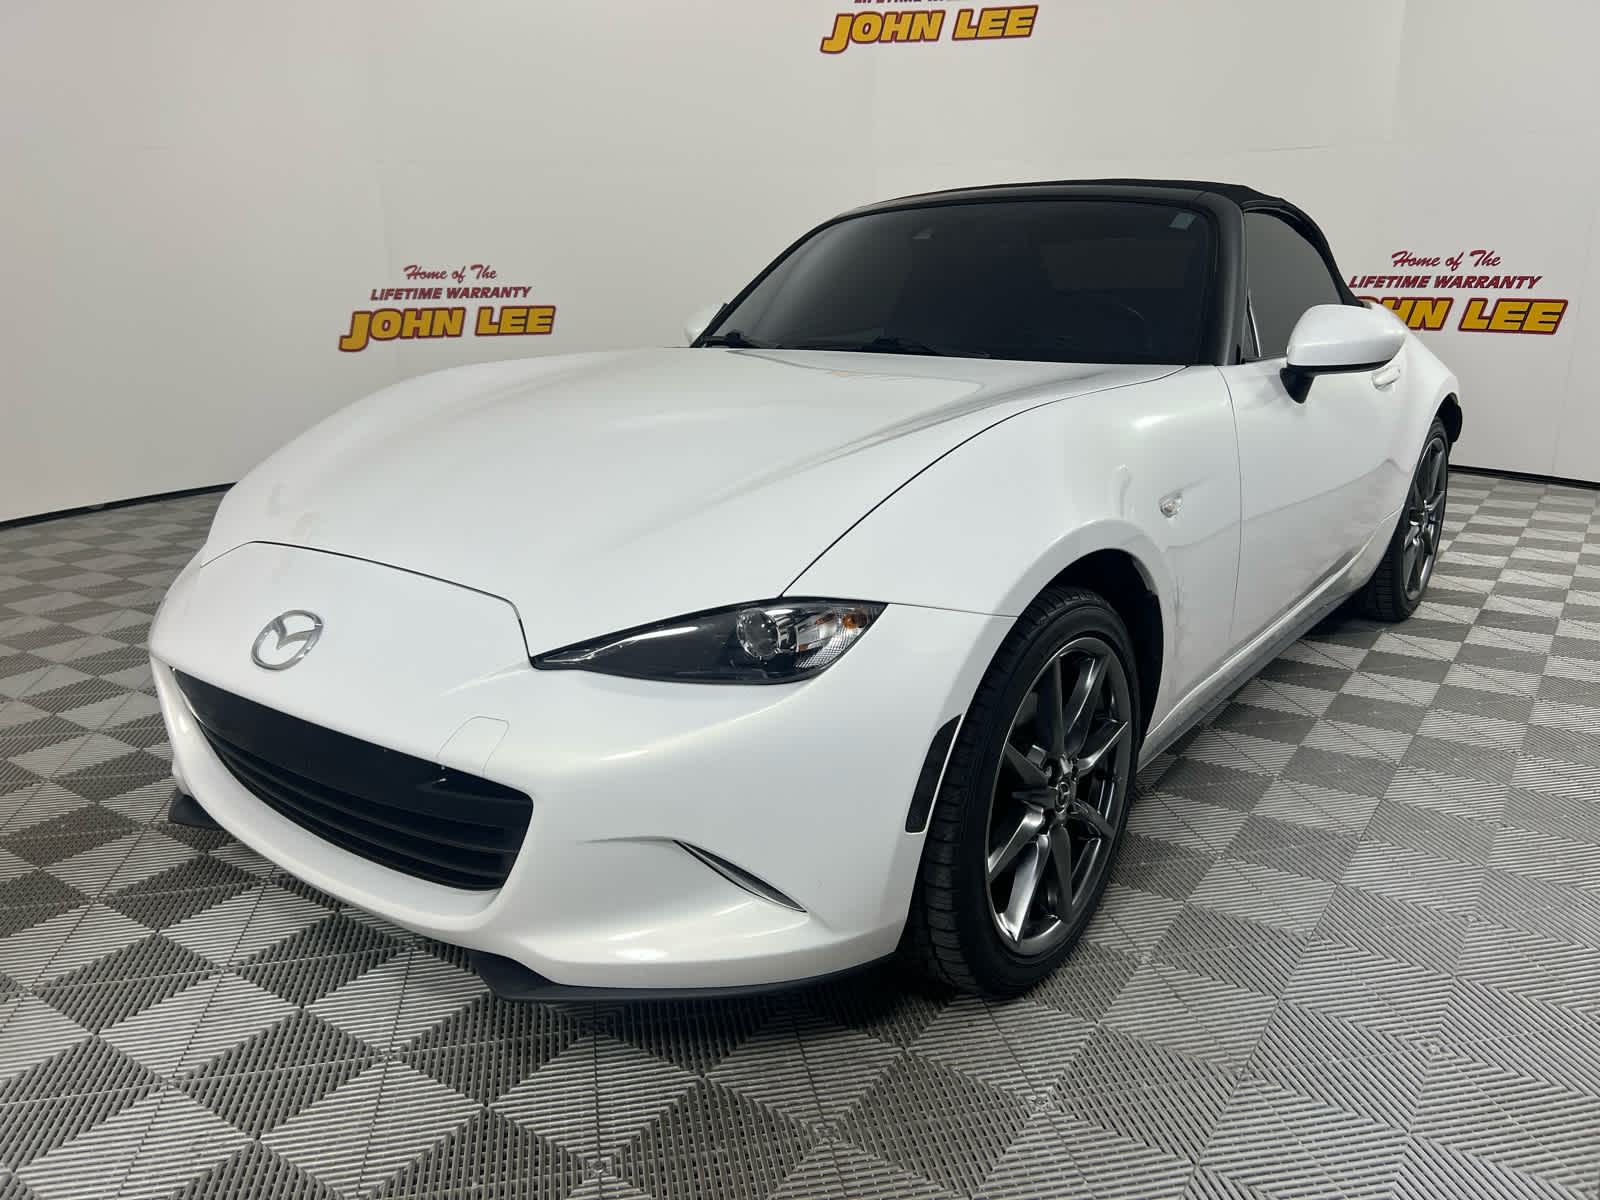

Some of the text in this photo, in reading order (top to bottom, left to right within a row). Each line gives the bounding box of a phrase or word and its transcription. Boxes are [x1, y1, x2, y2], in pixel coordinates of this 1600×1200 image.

[820, 4, 1039, 54] JOHN LEE
[1391, 249, 1501, 271] Home of The
[403, 264, 497, 283] Home of The
[1349, 275, 1543, 289] LIFETIME WARRANTY
[370, 286, 532, 301] LIFETIME WARRANTY
[1355, 295, 1569, 335] HN LEE
[338, 305, 556, 352] JOHN LEE
